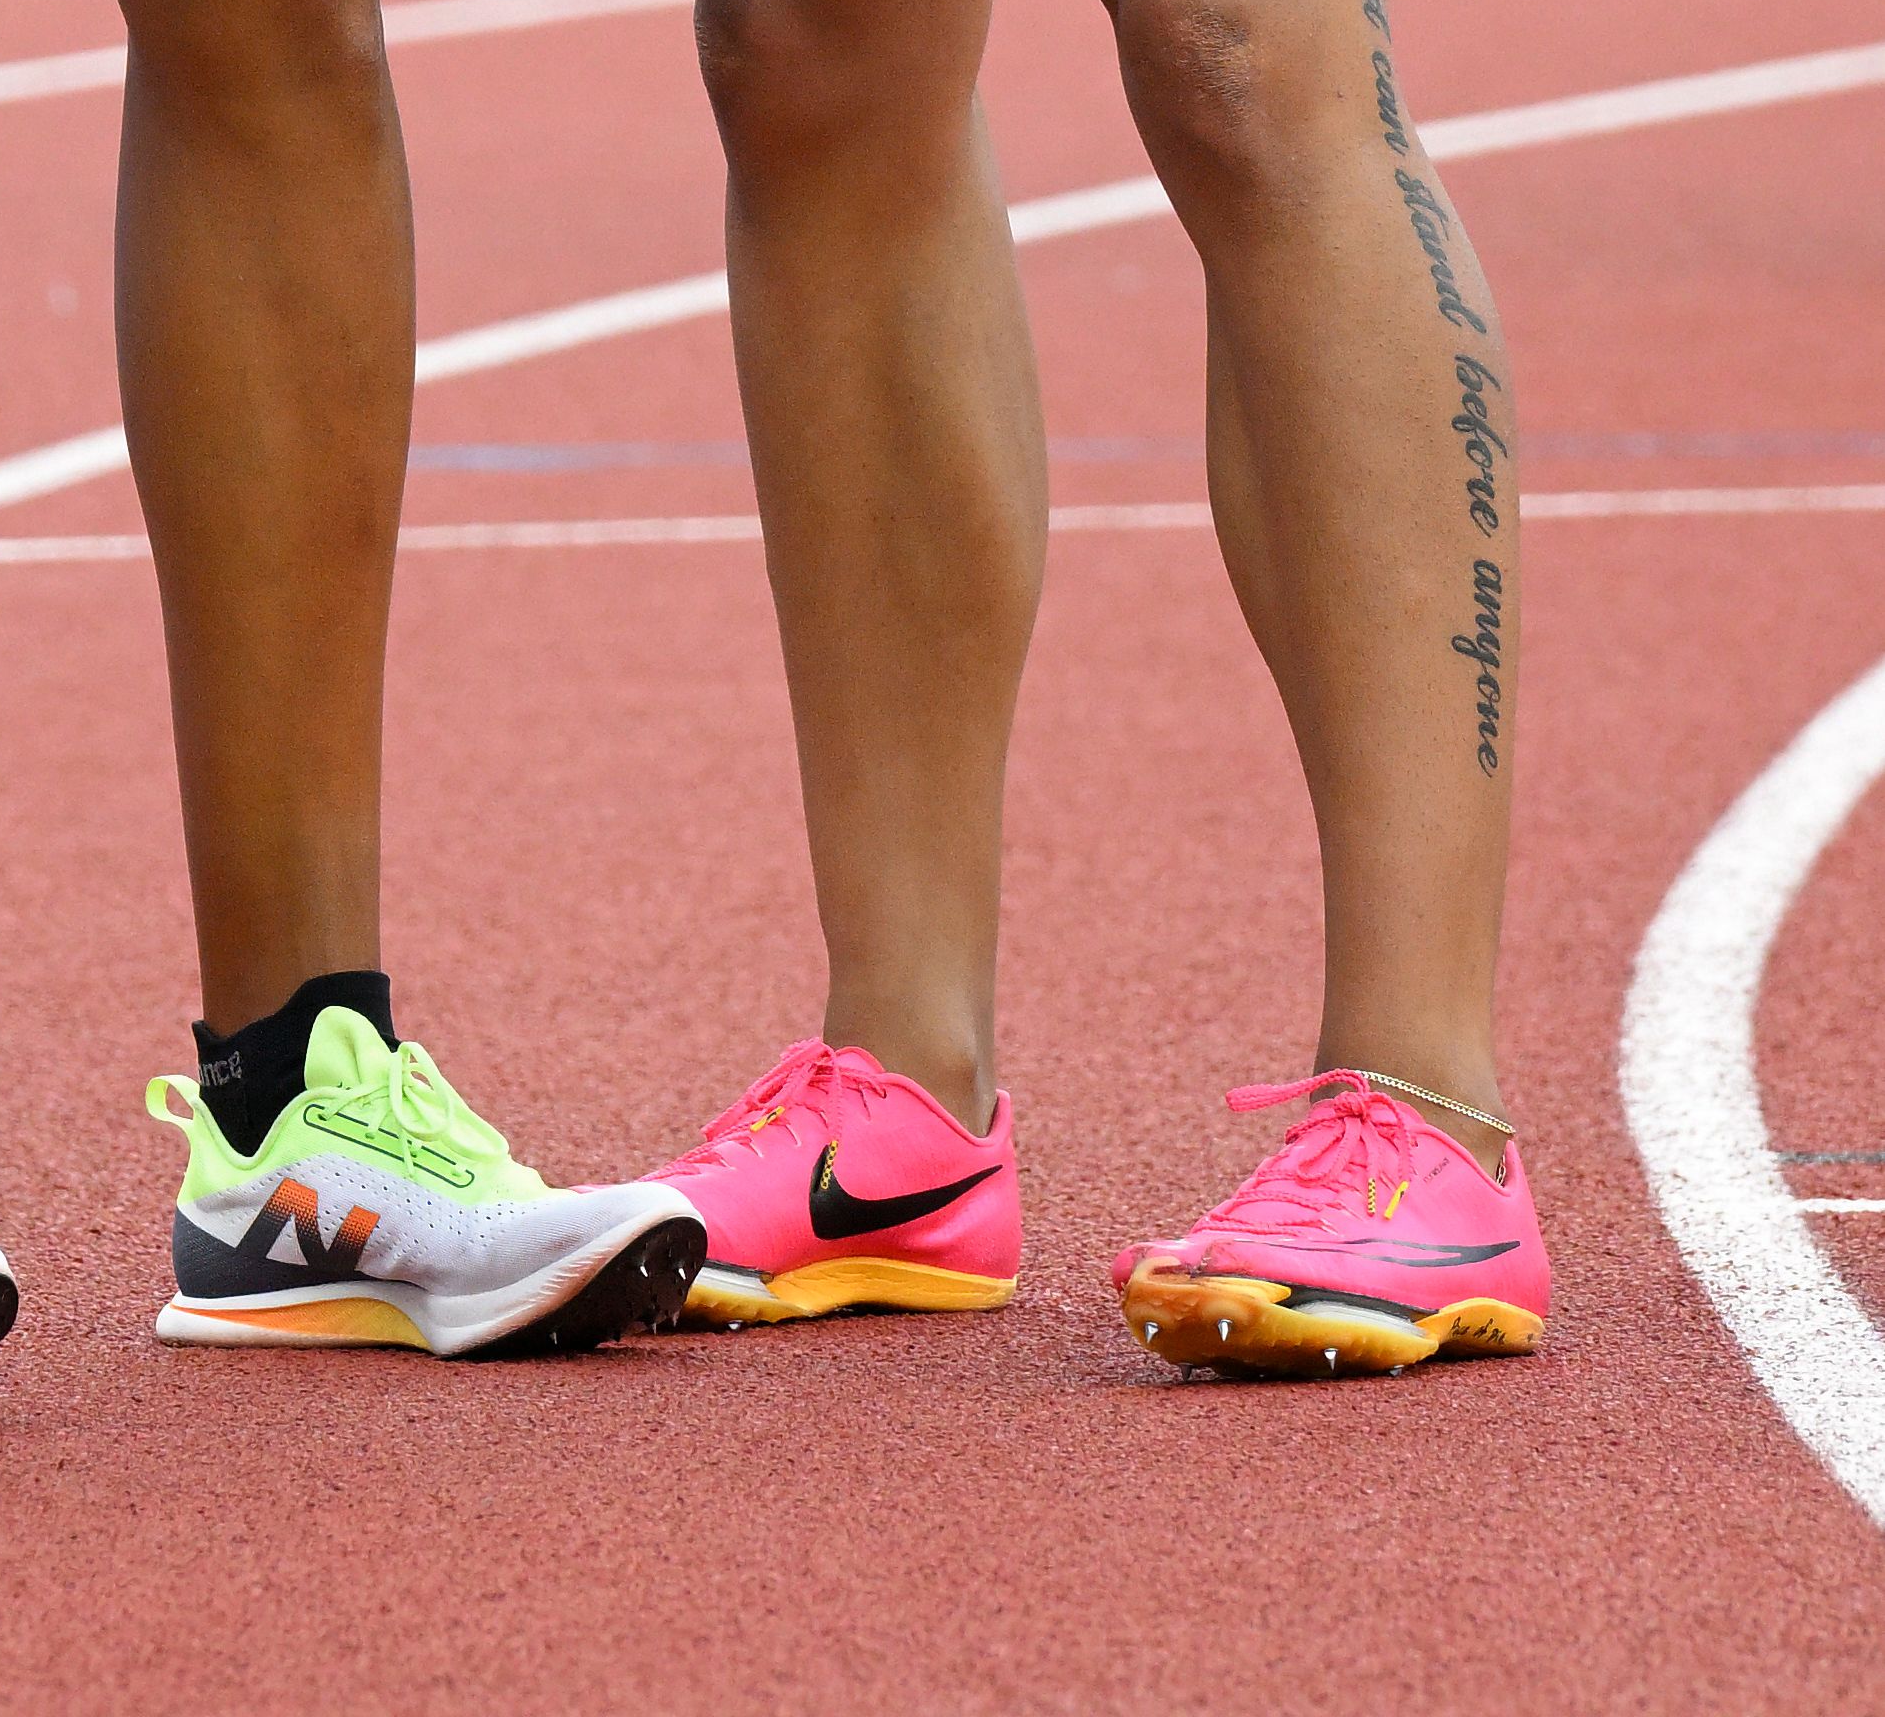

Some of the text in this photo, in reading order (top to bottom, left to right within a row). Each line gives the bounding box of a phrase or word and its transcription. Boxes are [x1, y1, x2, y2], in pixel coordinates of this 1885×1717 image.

[1371, 51, 1411, 155] can
[1393, 167, 1489, 336] stand
[1450, 355, 1507, 539] before
[1450, 558, 1507, 780] anyone
